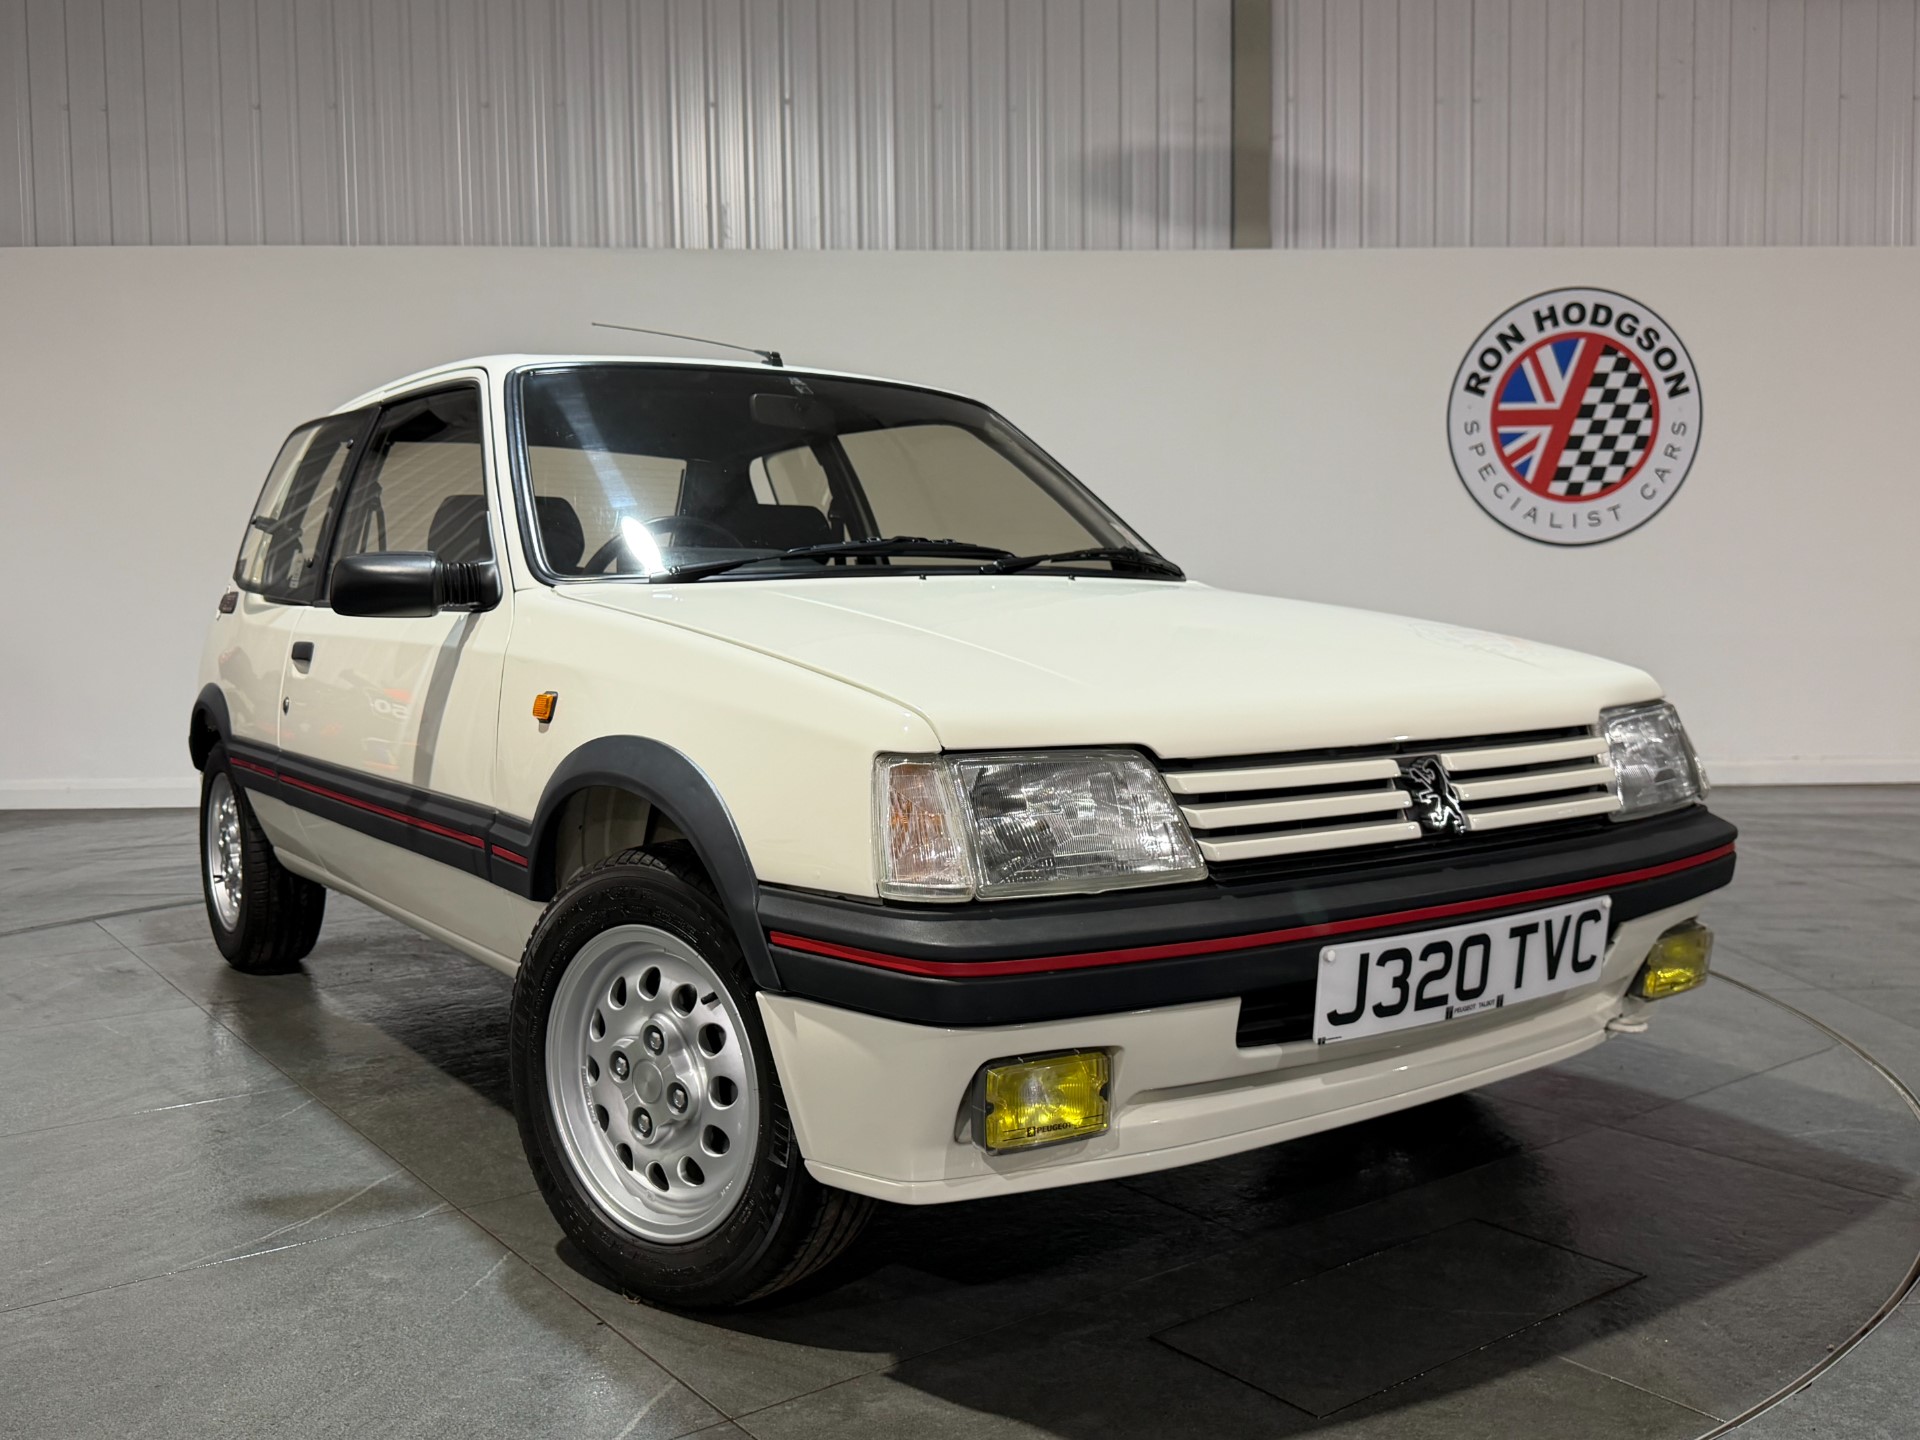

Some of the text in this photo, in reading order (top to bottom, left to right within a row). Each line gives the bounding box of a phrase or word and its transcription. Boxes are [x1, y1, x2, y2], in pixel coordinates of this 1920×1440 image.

[1464, 302, 1690, 399] RON HODGSON
[1464, 420, 1687, 529] SPECIALIST CARS
[1326, 909, 1602, 1026] J320 TVC
[1036, 1122, 1072, 1134] PEUGEOT
